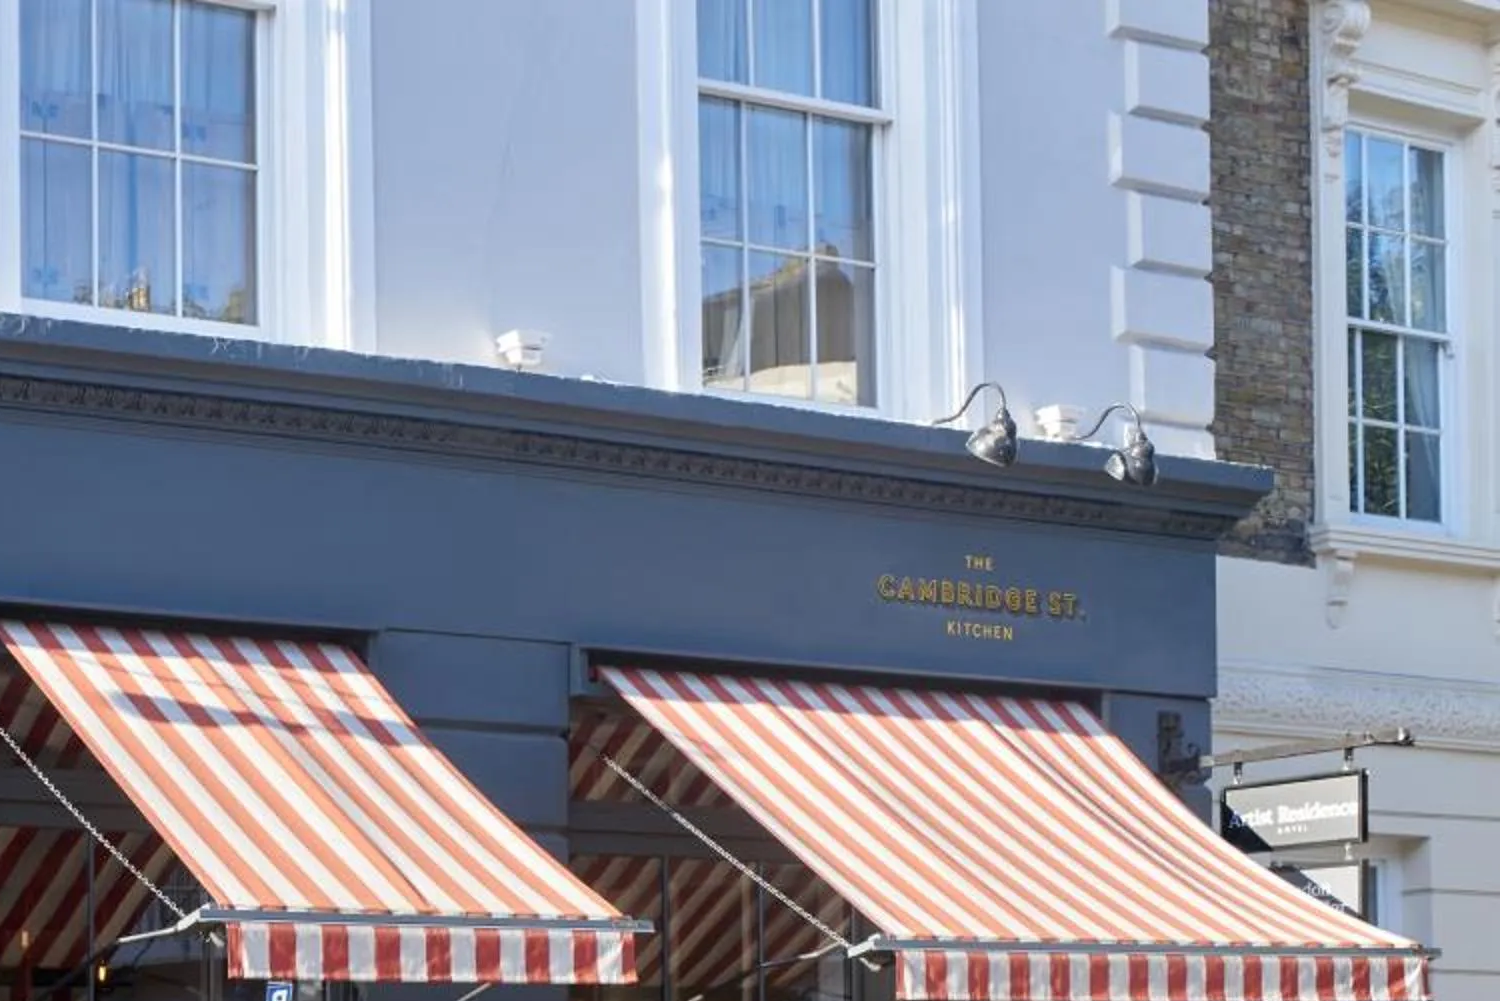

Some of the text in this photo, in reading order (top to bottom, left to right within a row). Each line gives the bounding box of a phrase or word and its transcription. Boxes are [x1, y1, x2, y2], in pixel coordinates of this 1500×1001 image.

[964, 555, 994, 571] THE
[876, 574, 1039, 614] CAMBRIDGE
[946, 619, 1014, 641] KITCHEN
